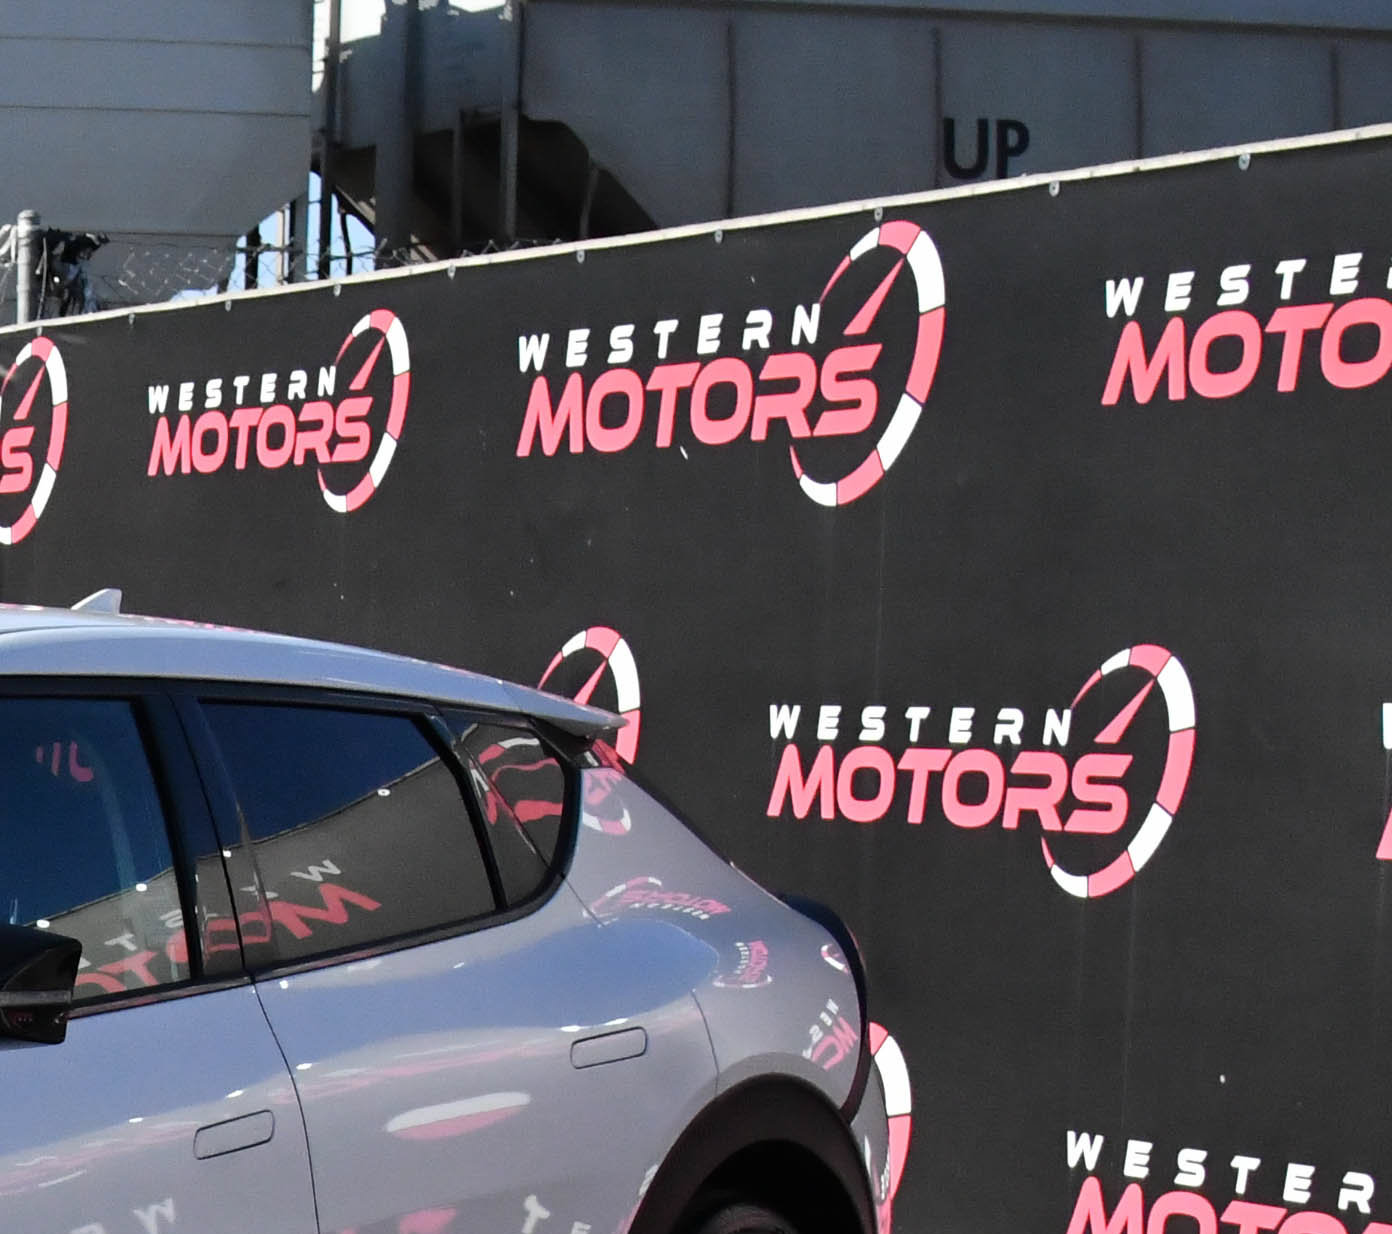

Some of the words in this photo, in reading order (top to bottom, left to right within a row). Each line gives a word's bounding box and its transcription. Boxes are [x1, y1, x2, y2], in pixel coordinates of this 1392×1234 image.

[943, 117, 1030, 180] UP
[1105, 252, 1392, 318] WESTE
[518, 303, 821, 374] WESTERN
[148, 365, 336, 414] WESTERN
[516, 343, 883, 458] MOTORS
[147, 396, 373, 477] MOTORS
[769, 704, 1072, 747] WESTERN
[767, 744, 1134, 834] MOTORS
[1066, 1130, 1375, 1215] WESTER
